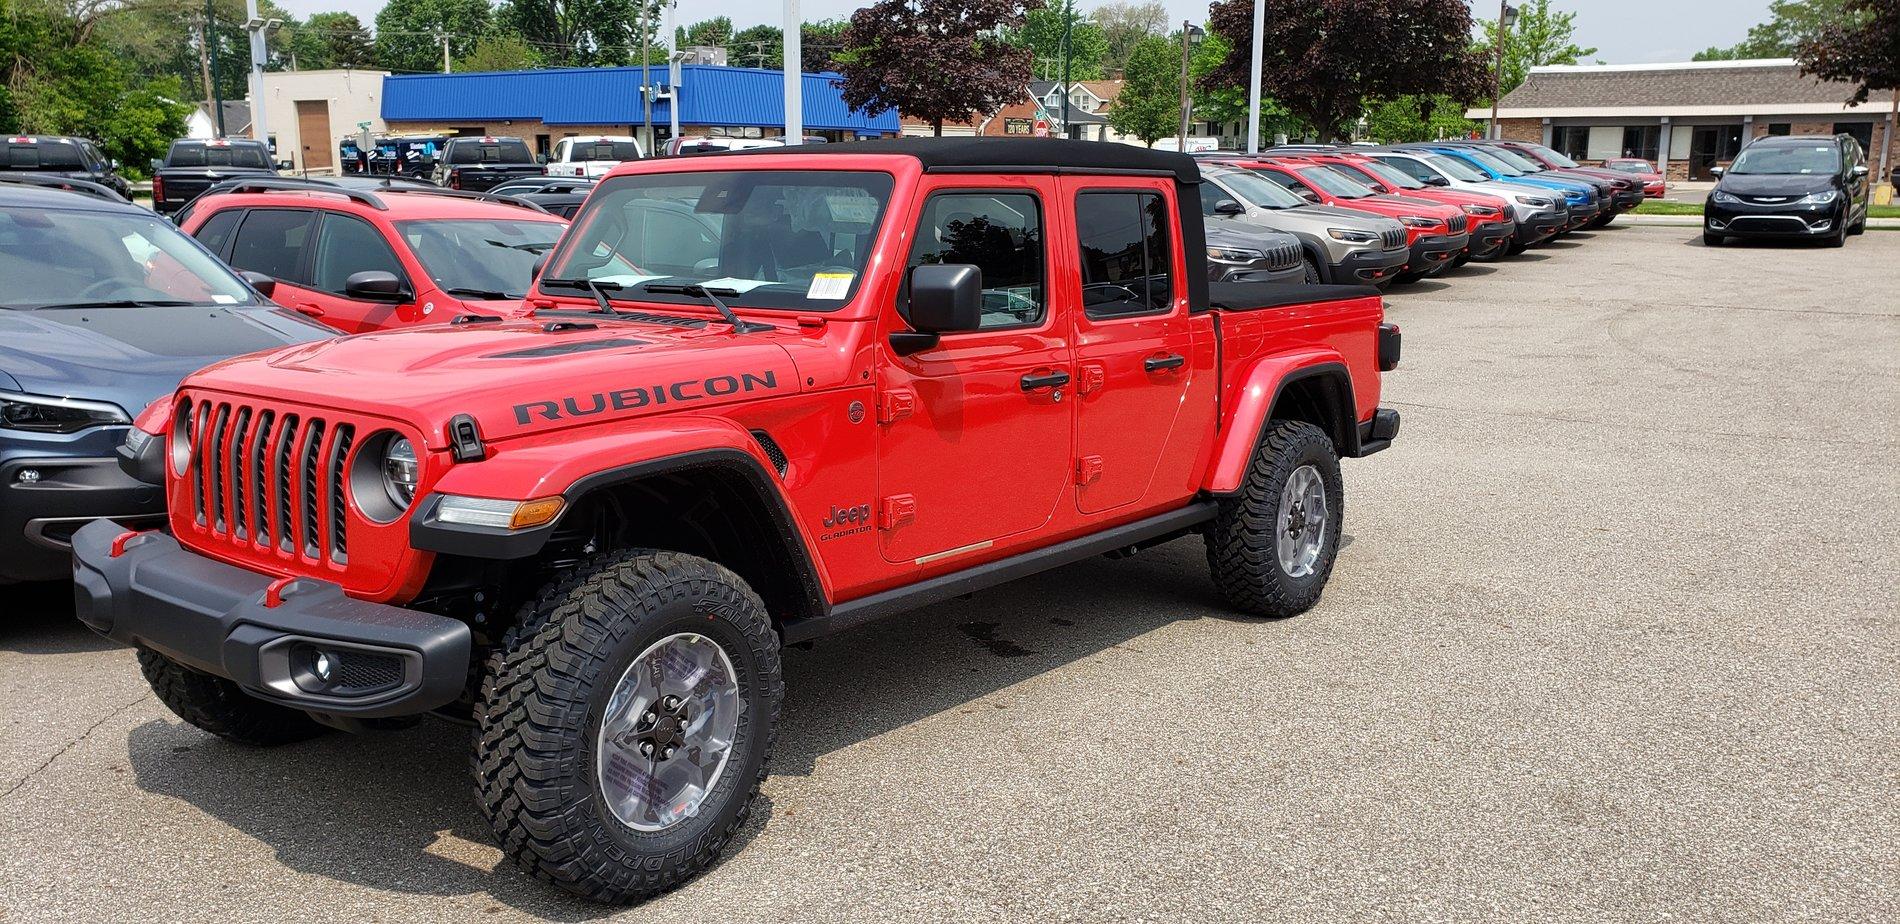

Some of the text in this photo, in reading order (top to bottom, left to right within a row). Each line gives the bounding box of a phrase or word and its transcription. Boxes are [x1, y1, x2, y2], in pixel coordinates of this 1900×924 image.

[1016, 124, 1030, 134] YEARS
[1035, 127, 1048, 137] STOP
[513, 370, 777, 425] RUBICON
[823, 504, 871, 527] Jeep
[820, 525, 872, 541] GLADIATOR
